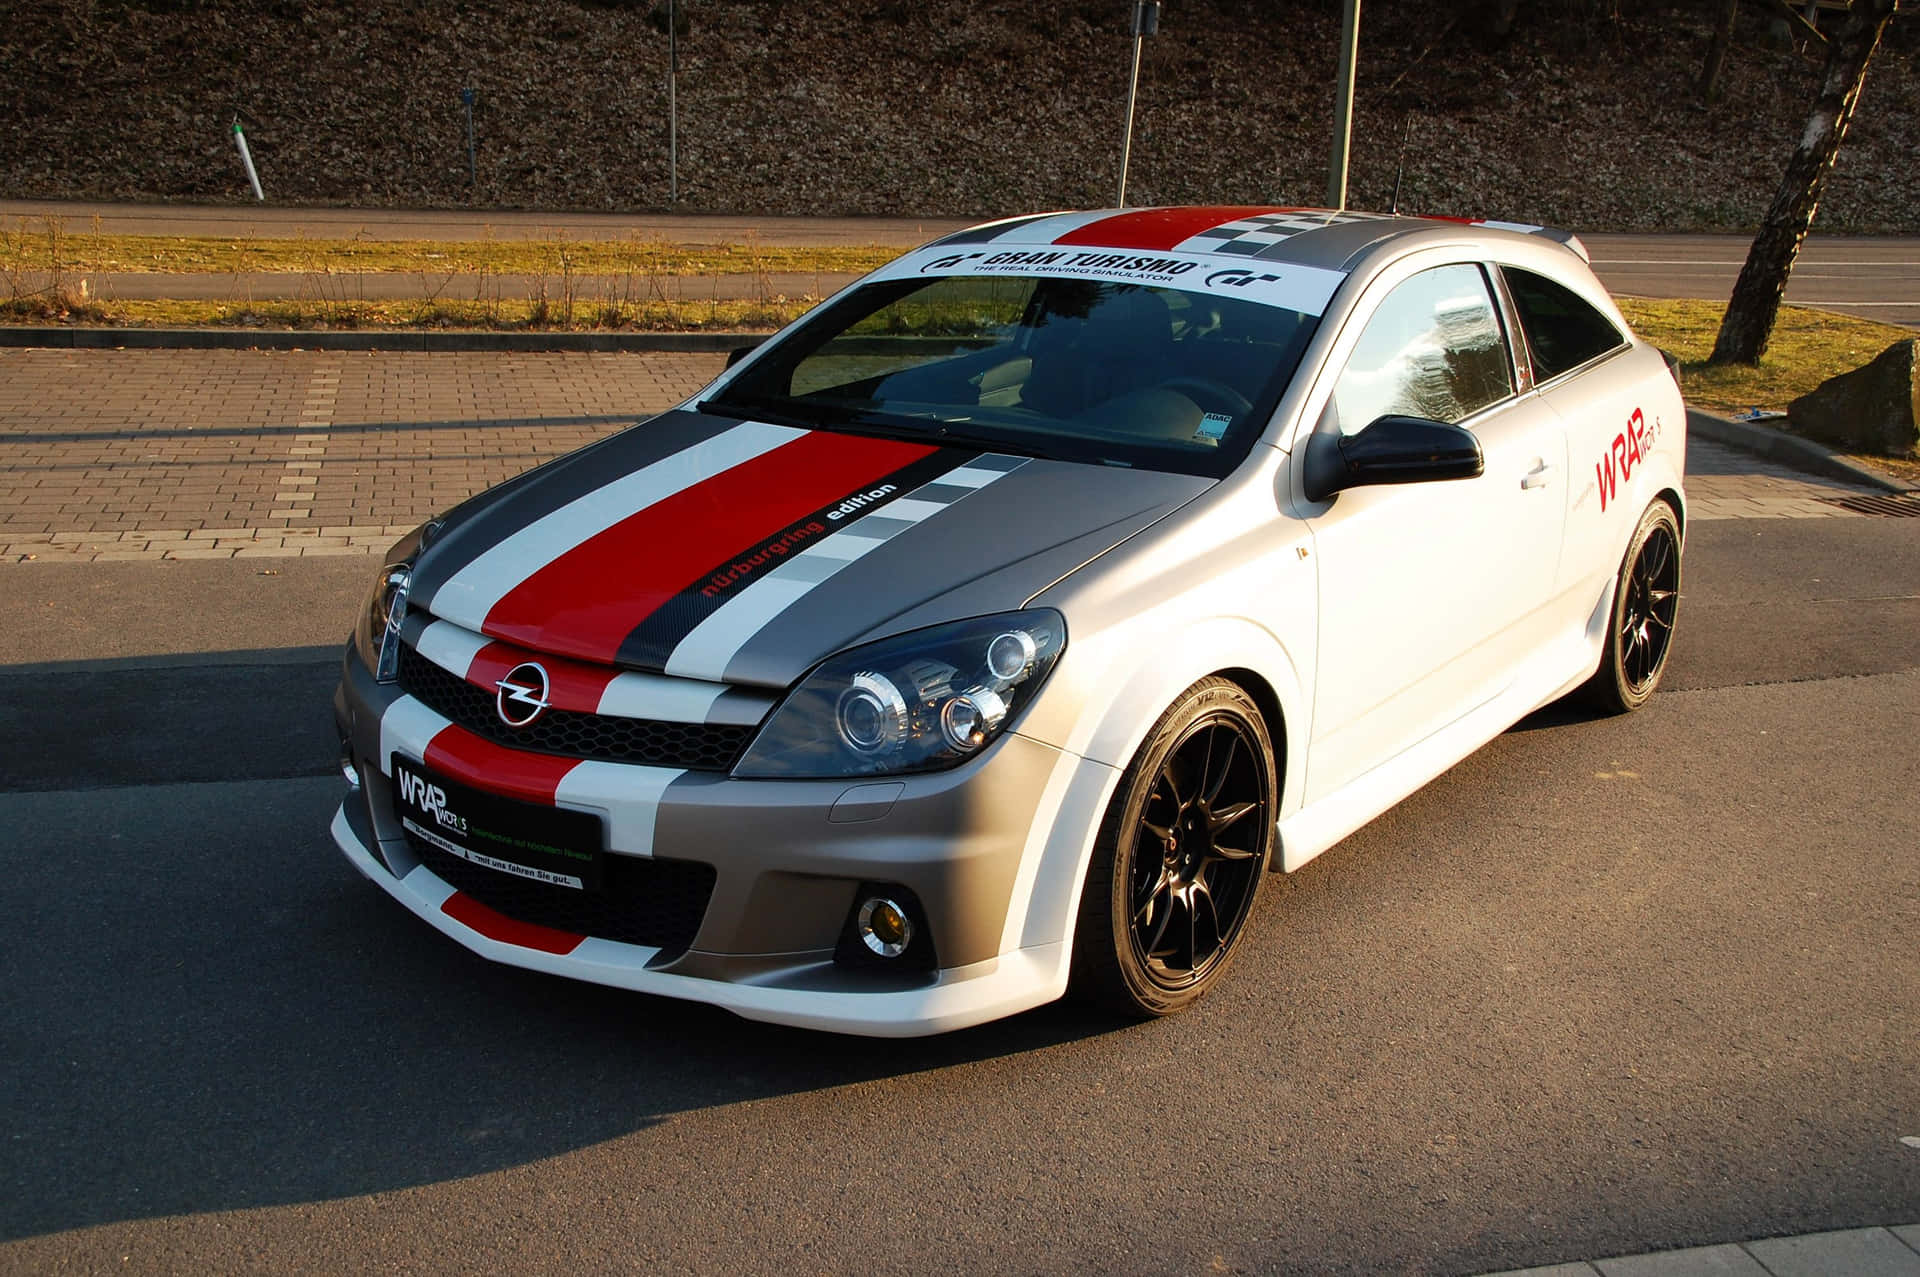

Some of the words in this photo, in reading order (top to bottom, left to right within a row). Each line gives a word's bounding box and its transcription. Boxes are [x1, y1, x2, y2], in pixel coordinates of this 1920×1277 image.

[983, 252, 1067, 265] GRAN
[1063, 252, 1199, 275] TURISMO
[1034, 266, 1090, 275] DRIVING
[1091, 269, 1175, 283] SIMULATOR
[1596, 407, 1644, 513] WRAP
[701, 521, 826, 598] nürburgring
[826, 483, 898, 521] edition
[398, 767, 447, 825] WRAP
[491, 860, 507, 869] uns
[508, 863, 535, 877] fahren
